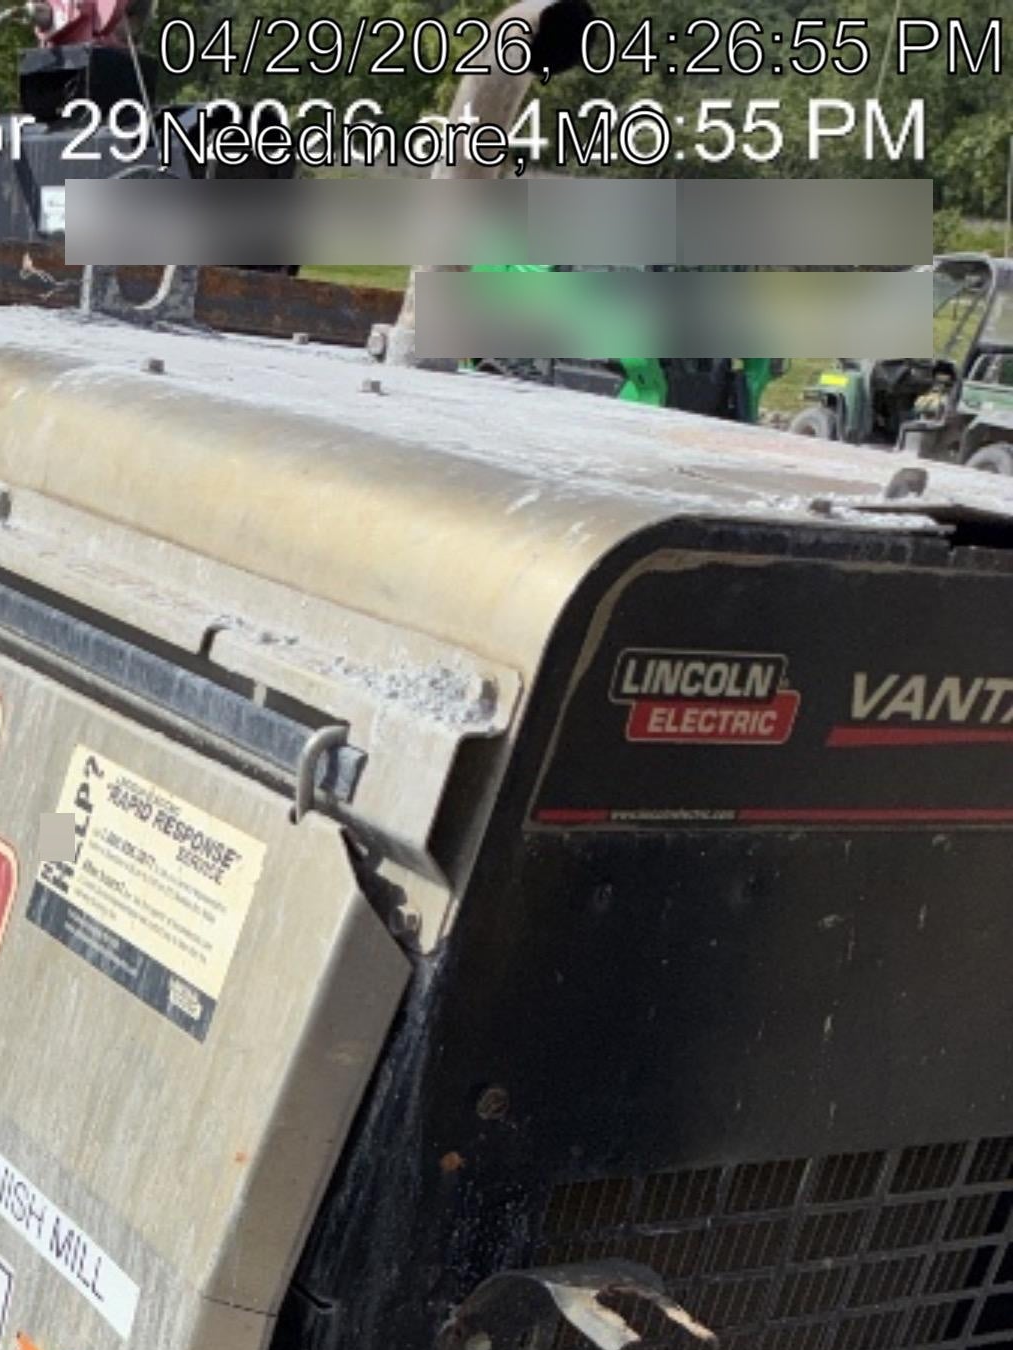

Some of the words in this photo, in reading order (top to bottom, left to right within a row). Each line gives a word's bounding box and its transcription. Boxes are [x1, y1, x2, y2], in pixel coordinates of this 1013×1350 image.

[621, 658, 775, 698] LINCOLN
[647, 707, 778, 736] ELECTRIC
[49, 1215, 105, 1302] MILL
